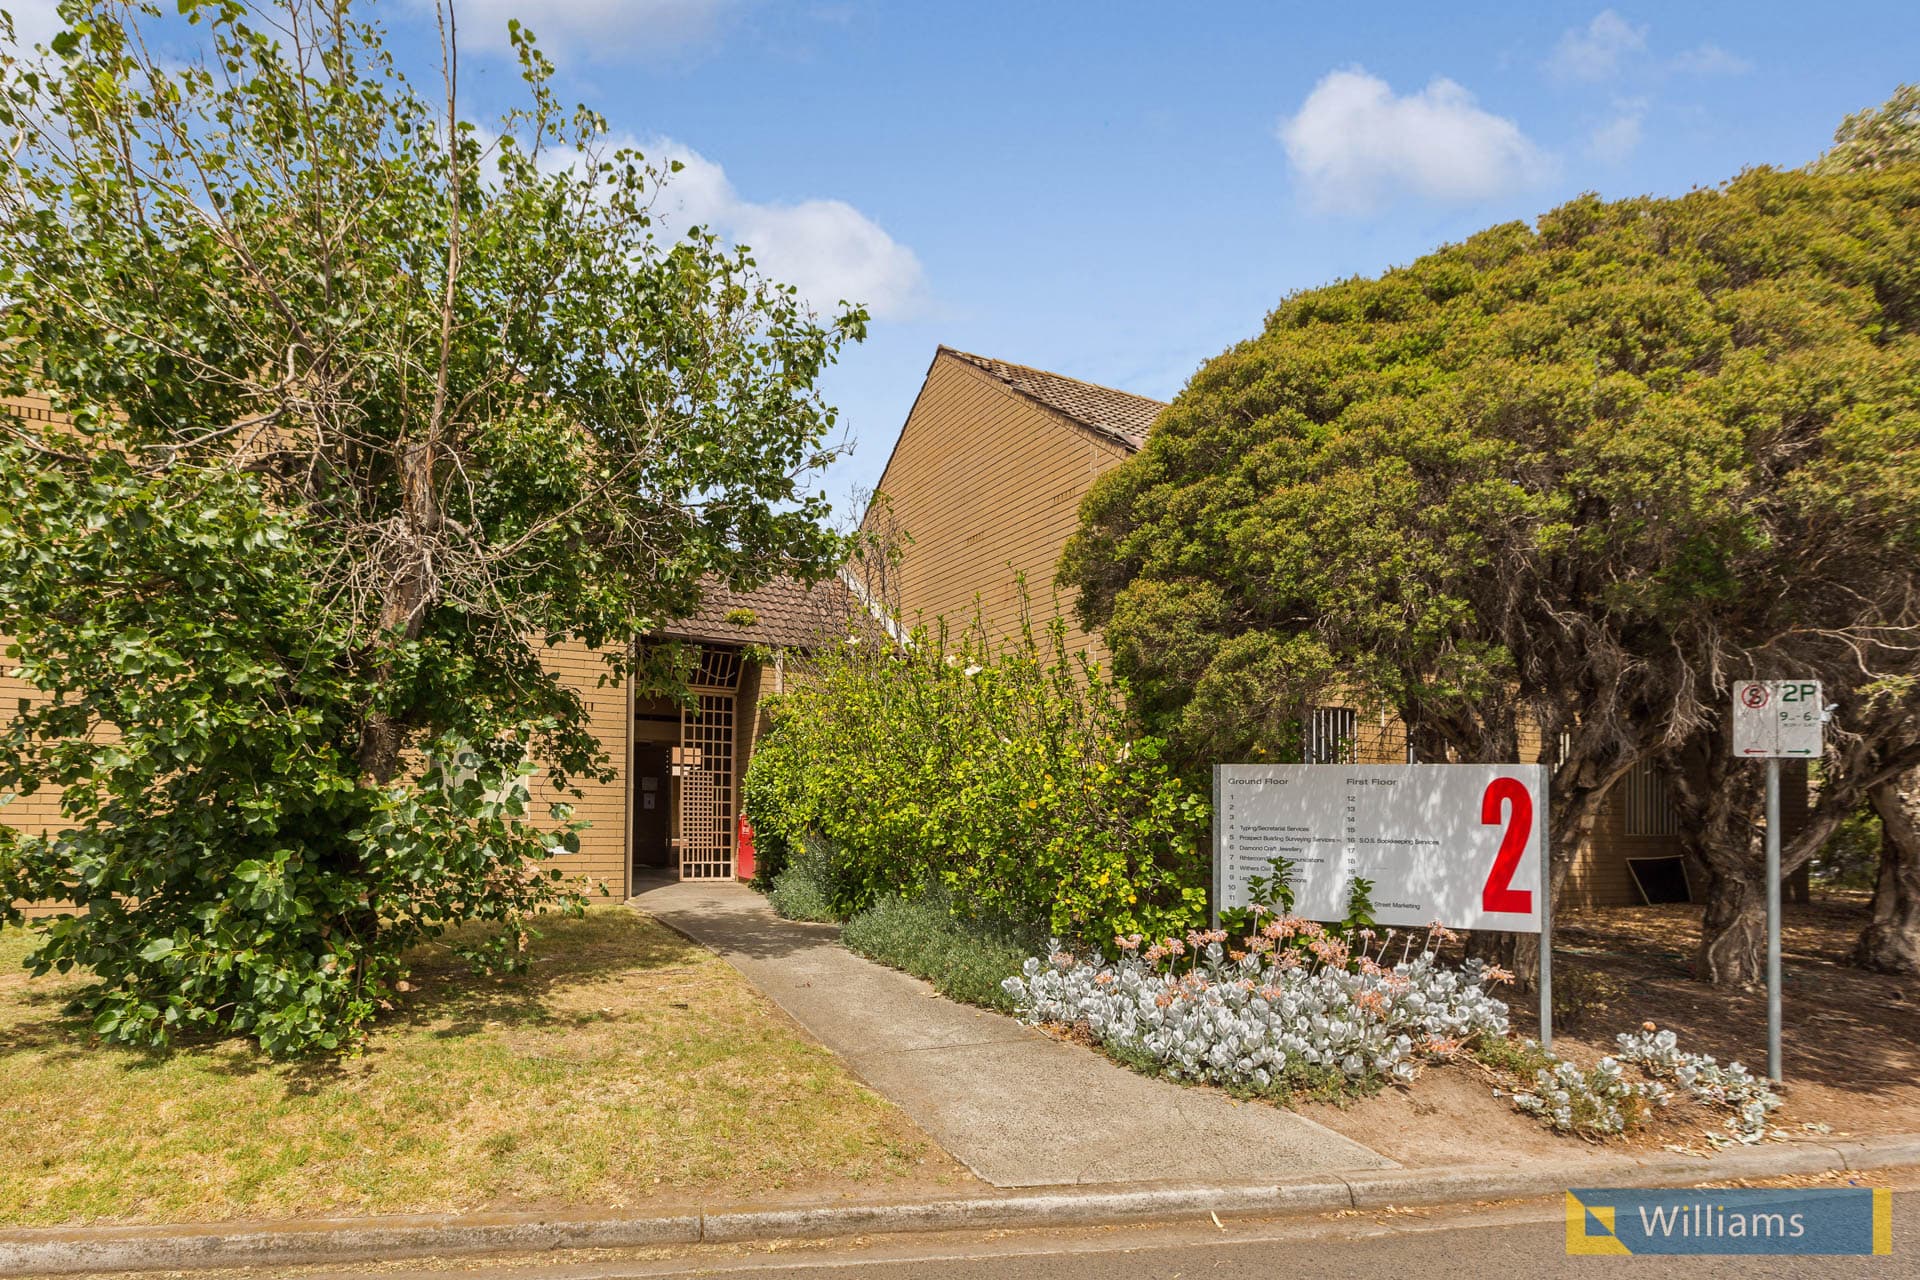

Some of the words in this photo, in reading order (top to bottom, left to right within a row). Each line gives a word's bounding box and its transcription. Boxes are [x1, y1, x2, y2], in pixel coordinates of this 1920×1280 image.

[1782, 684, 1816, 701] 2P
[1377, 838, 1414, 846] Bookkeeping
[1481, 777, 1533, 914] 2
[1392, 902, 1420, 910] Marketing
